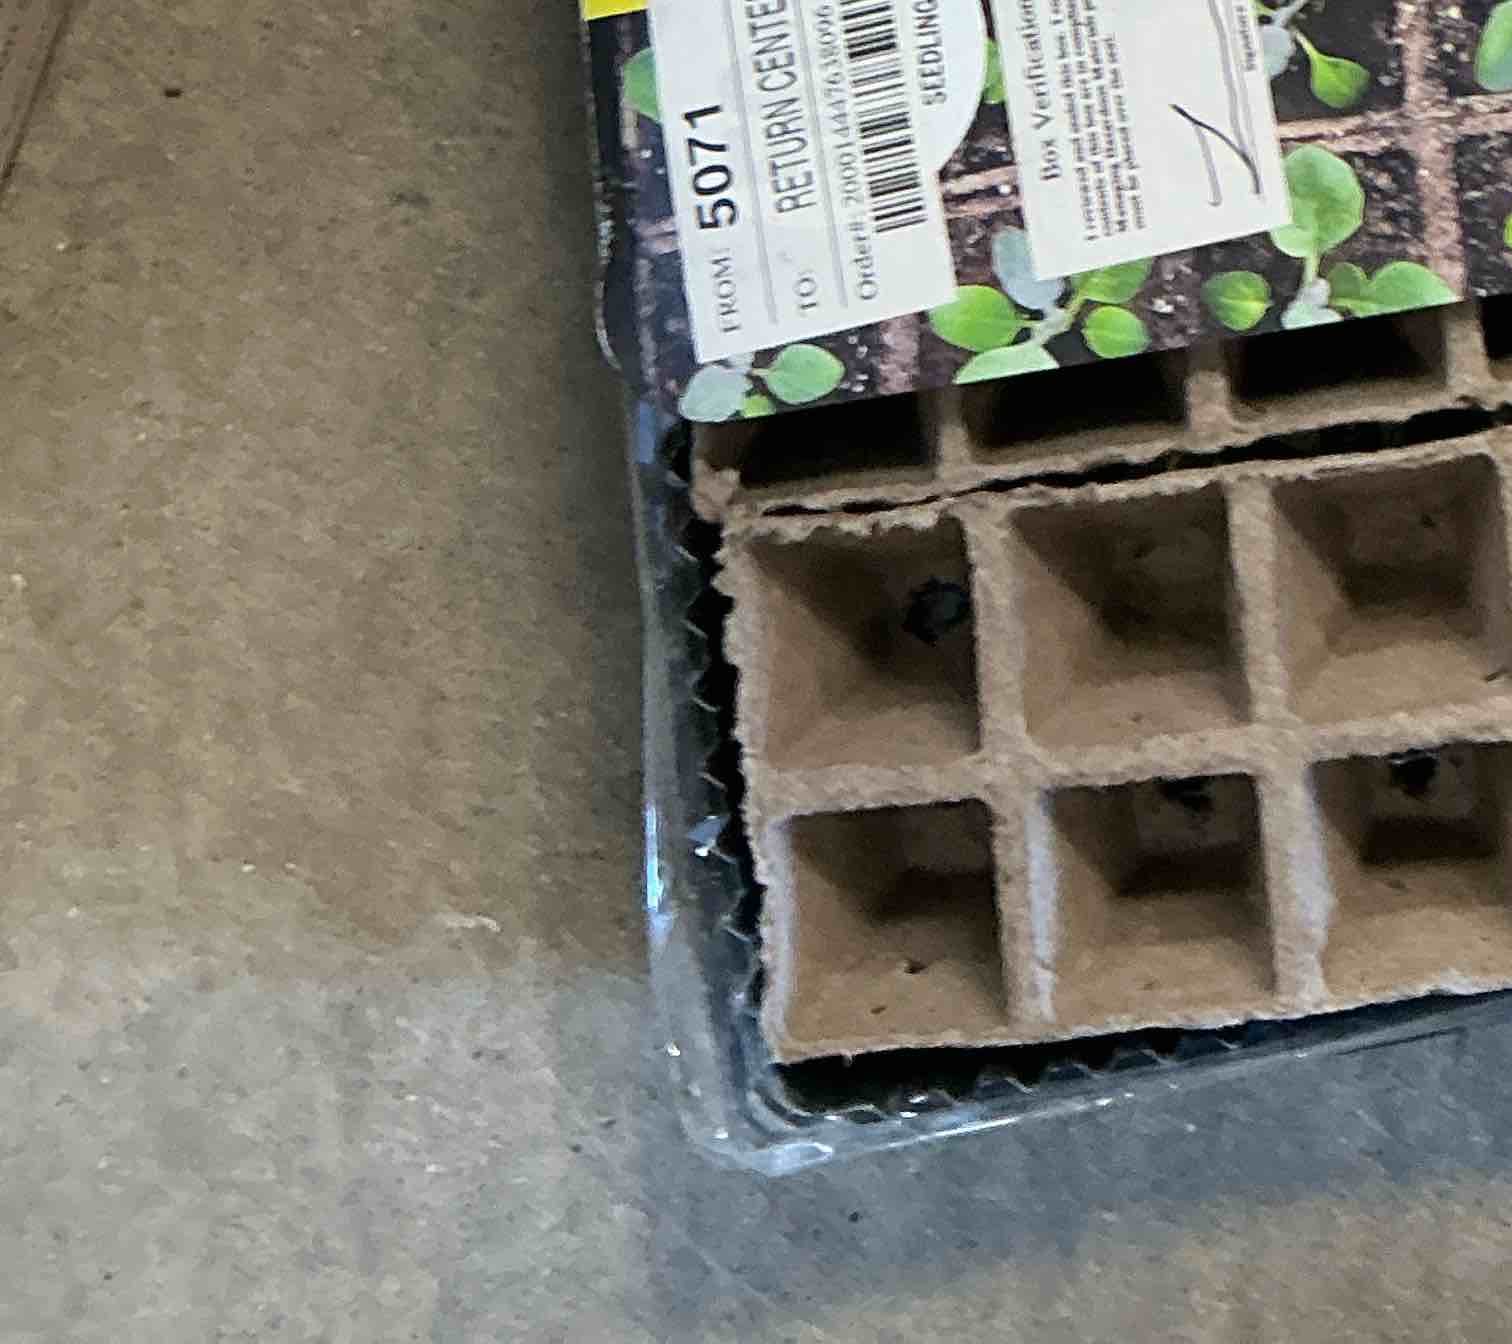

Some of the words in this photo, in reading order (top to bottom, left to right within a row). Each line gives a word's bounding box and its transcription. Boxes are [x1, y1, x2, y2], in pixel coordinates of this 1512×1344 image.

[677, 100, 742, 231] 5071
[756, 95, 819, 214] RETURN
[1033, 137, 1063, 182] Box
[791, 270, 821, 312] TO:
